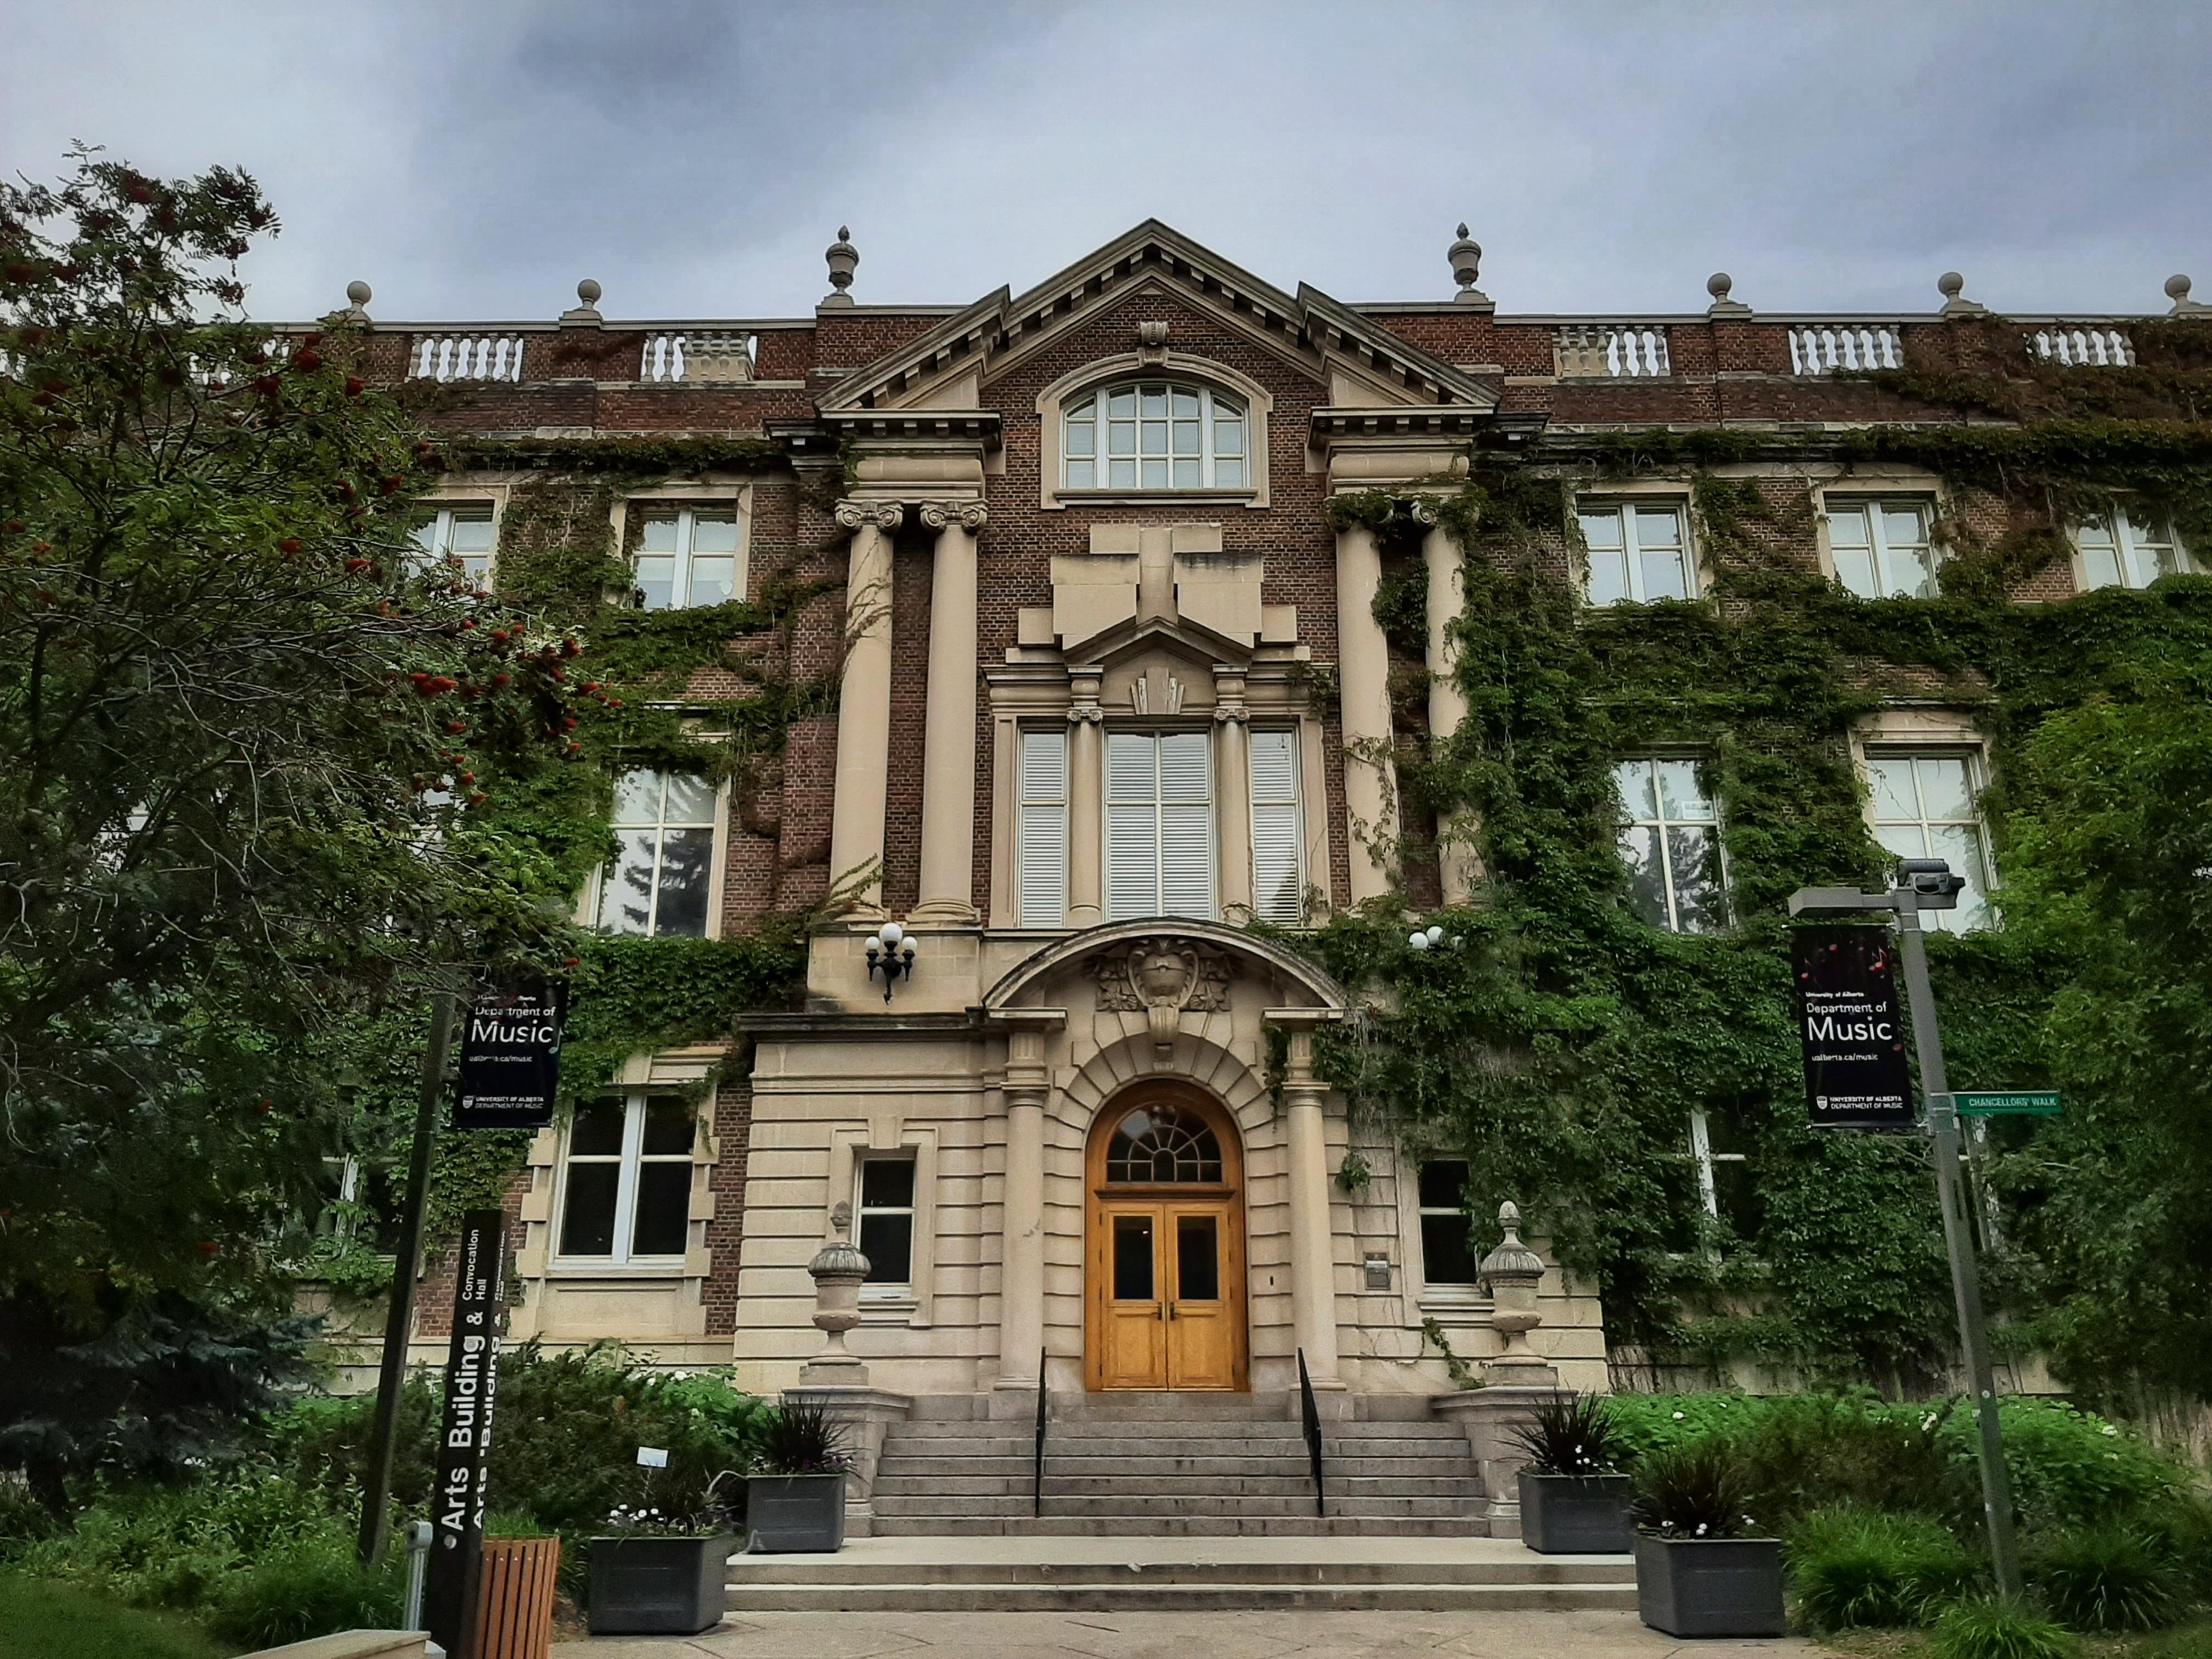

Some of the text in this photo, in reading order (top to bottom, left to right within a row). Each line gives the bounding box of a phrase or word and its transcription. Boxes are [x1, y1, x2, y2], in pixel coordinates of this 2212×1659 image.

[543, 1006, 556, 1016] of
[1806, 1001, 1887, 1015] Department of
[471, 1019, 554, 1042] Music
[1808, 1015, 1892, 1041] Music
[2032, 1098, 2056, 1106] WALK
[462, 1229, 479, 1301] Convocation
[475, 1279, 487, 1300] Hall
[441, 1311, 486, 1531] Arts Building &
[474, 1467, 487, 1530] Arts
[481, 1336, 500, 1447] Building
